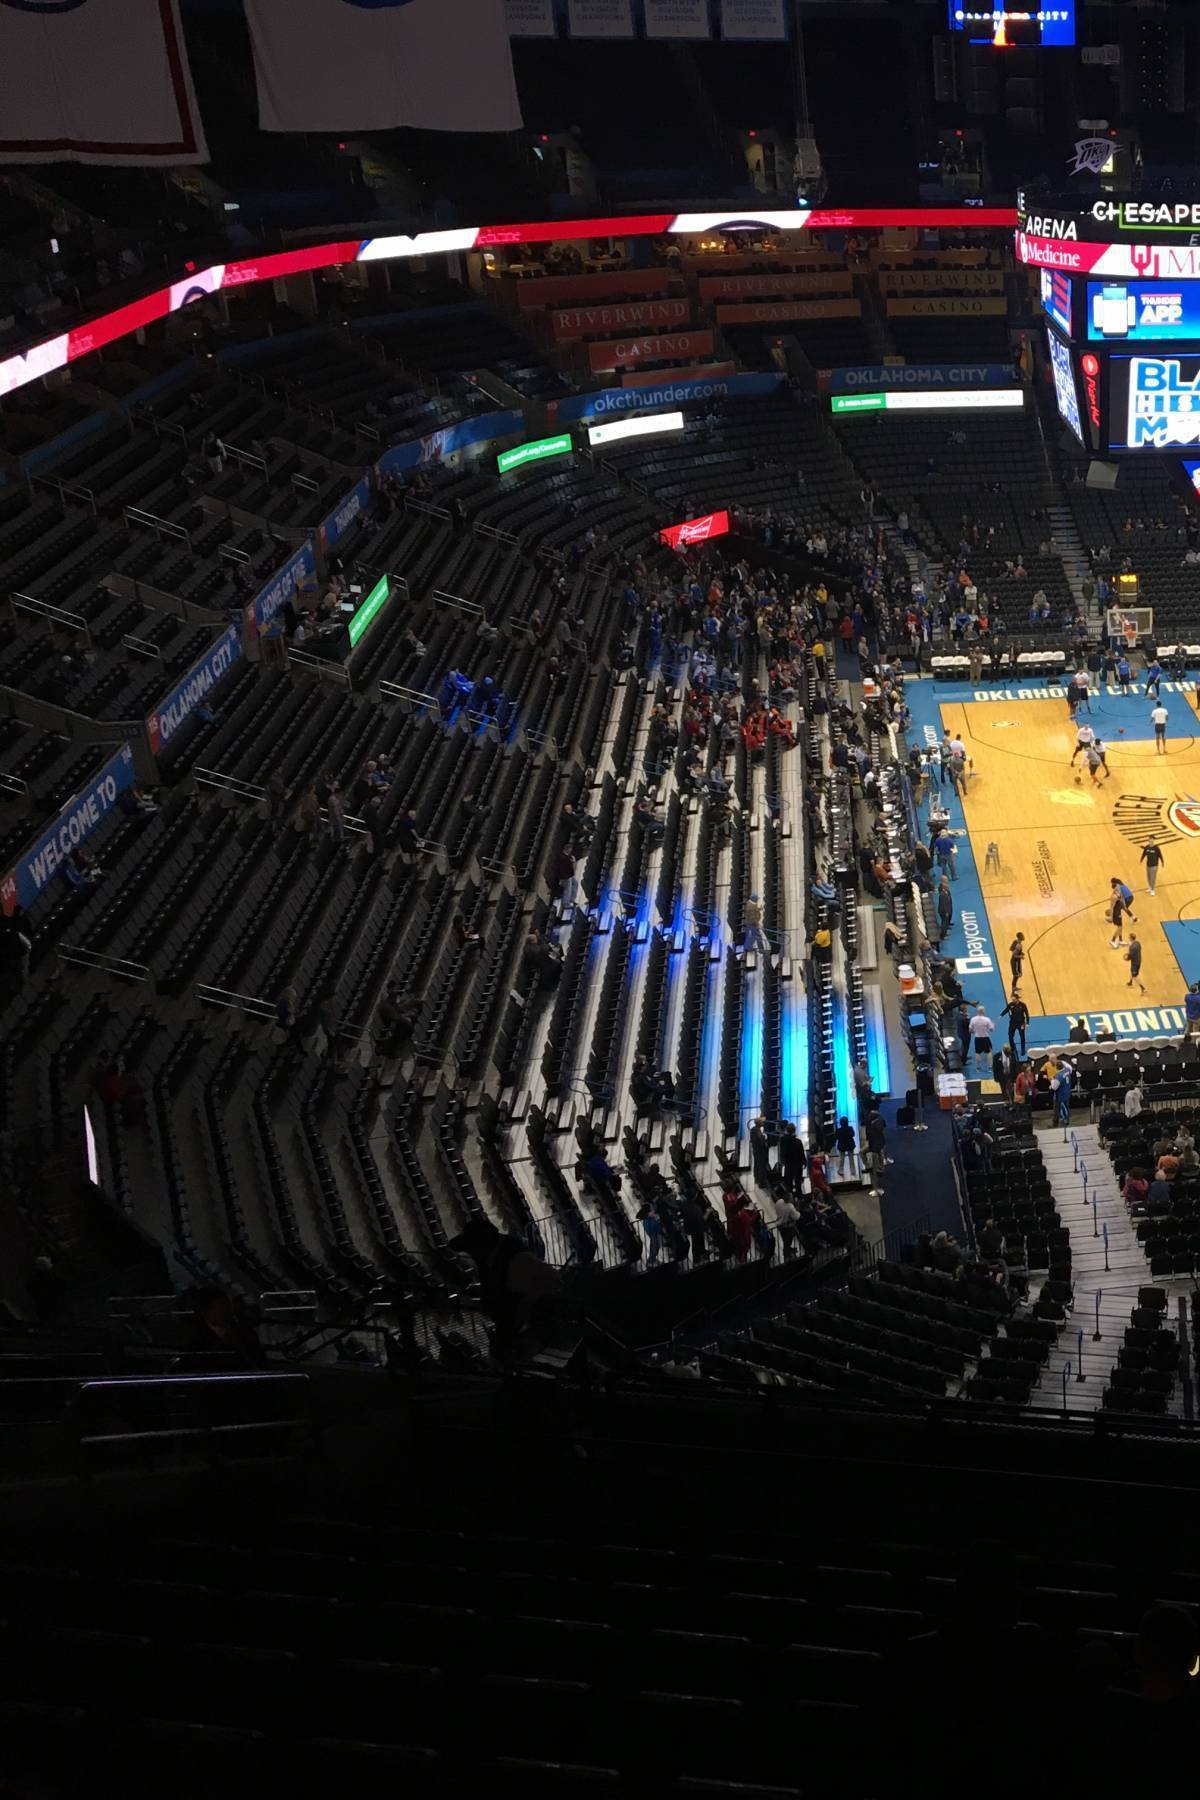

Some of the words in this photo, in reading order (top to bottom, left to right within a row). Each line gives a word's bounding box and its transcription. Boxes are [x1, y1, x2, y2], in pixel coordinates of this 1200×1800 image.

[1036, 10, 1069, 20] CITY
[1025, 215, 1078, 241] ARENA
[1027, 240, 1081, 267] Medicine
[559, 302, 687, 329] RIVERWIND
[913, 301, 984, 314] CASINO
[1139, 305, 1183, 323] APP
[615, 337, 690, 358] CASINO
[845, 369, 945, 384] OKLAHOMA
[947, 368, 988, 383] CITY
[594, 382, 729, 413] okcthunder.com
[159, 665, 214, 739] OKLAHOMA
[211, 640, 233, 677] CITY
[973, 685, 1100, 701] OKLAHOA
[1106, 683, 1154, 696] CTY
[28, 793, 100, 890] WELCOME
[97, 775, 117, 810] TO
[961, 910, 991, 958] paycom
